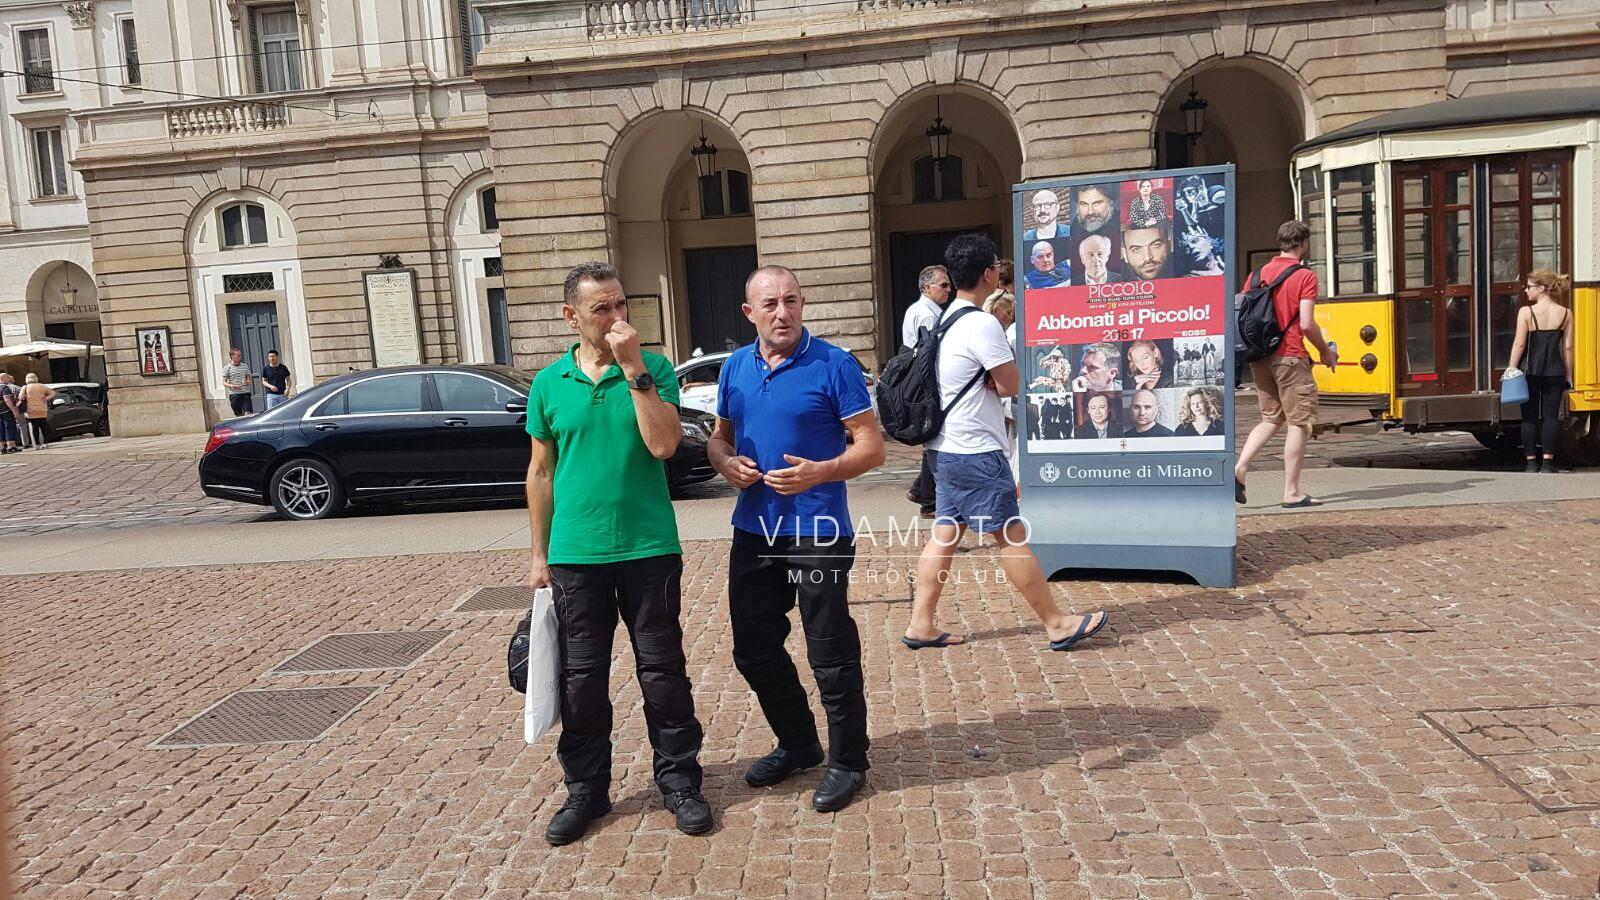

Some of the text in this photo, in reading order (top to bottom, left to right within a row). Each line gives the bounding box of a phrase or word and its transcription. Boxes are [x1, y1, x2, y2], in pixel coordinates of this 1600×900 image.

[1089, 281, 1155, 299] PICCOLO
[1037, 304, 1210, 331] Abbonati al Piccolo!
[1067, 464, 1213, 479] Comune di Milano
